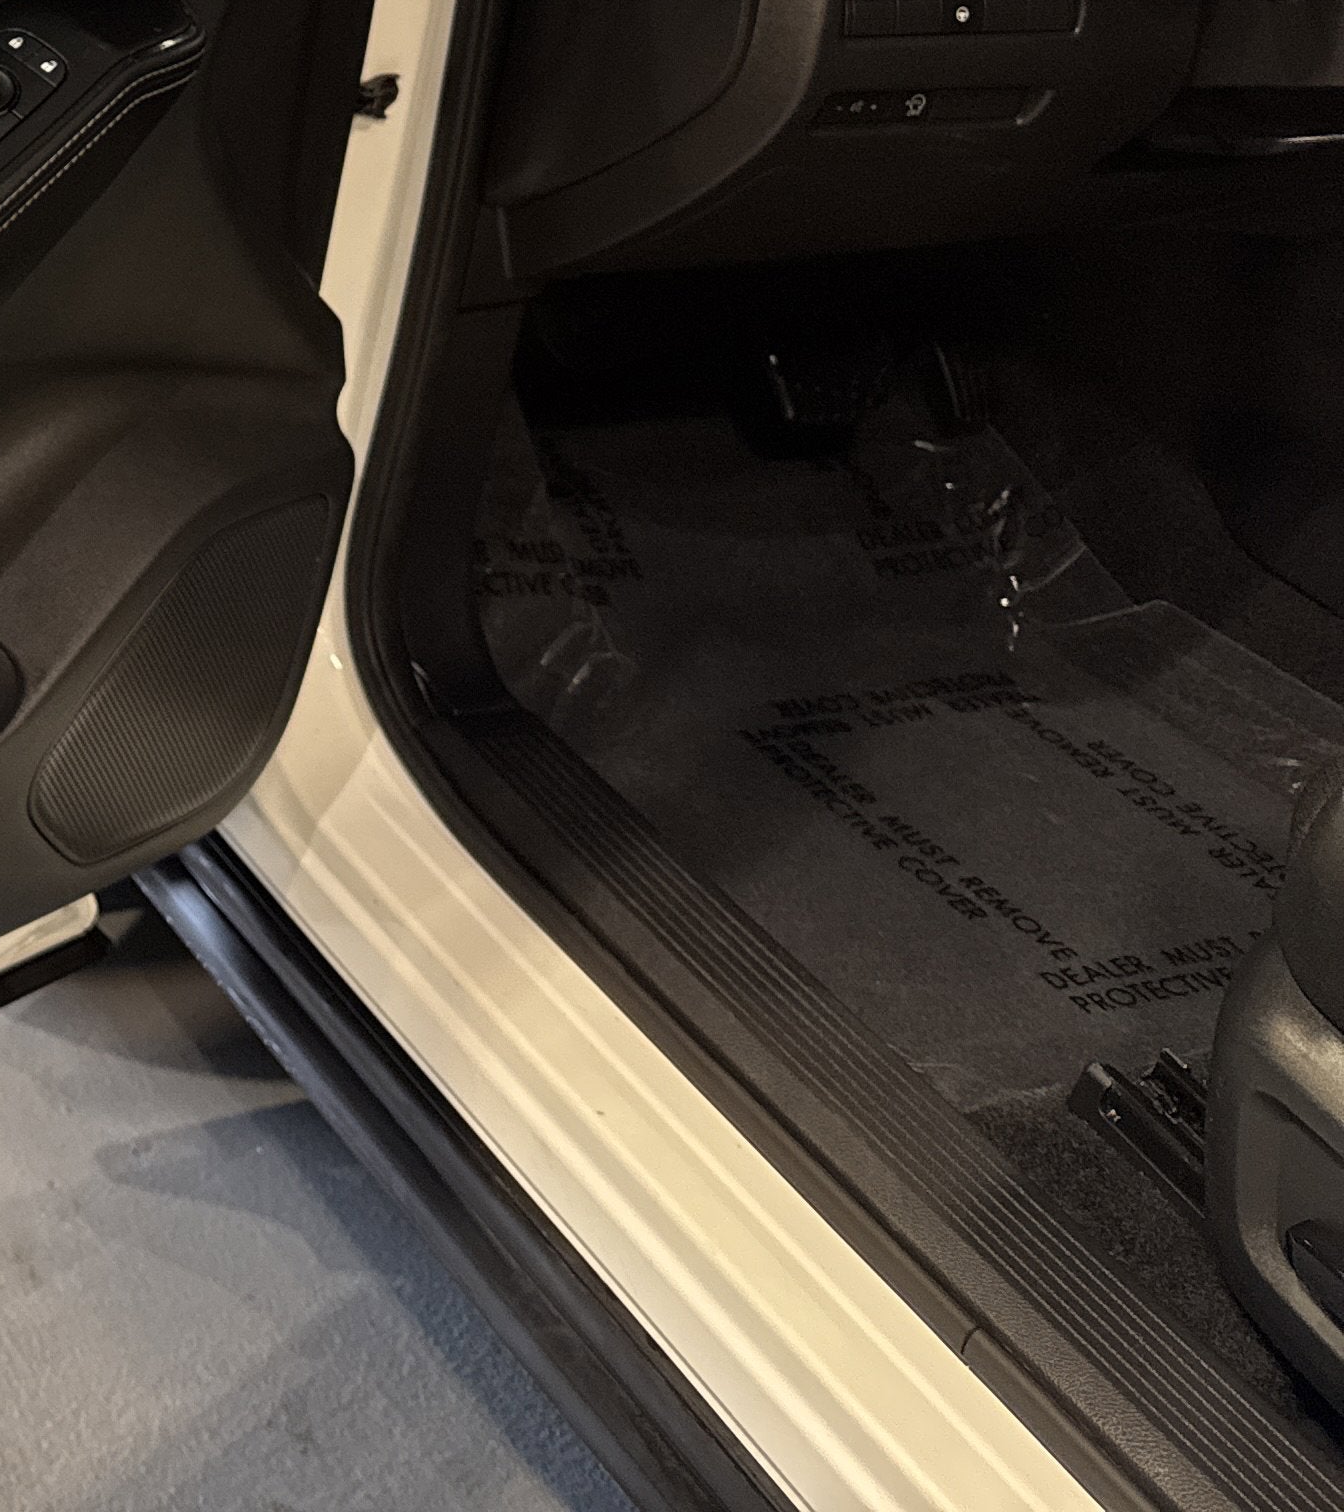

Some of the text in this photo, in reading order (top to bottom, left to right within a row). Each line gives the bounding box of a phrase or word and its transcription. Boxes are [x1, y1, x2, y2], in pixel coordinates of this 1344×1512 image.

[1007, 706, 1280, 901] ALER MUST REMOVE
[1087, 739, 1287, 882] TECTIVE COVER
[878, 815, 961, 867] MUST
[960, 876, 1078, 961] REMOVE
[898, 855, 988, 919] COVER
[1040, 936, 1245, 990] DEALER MUST
